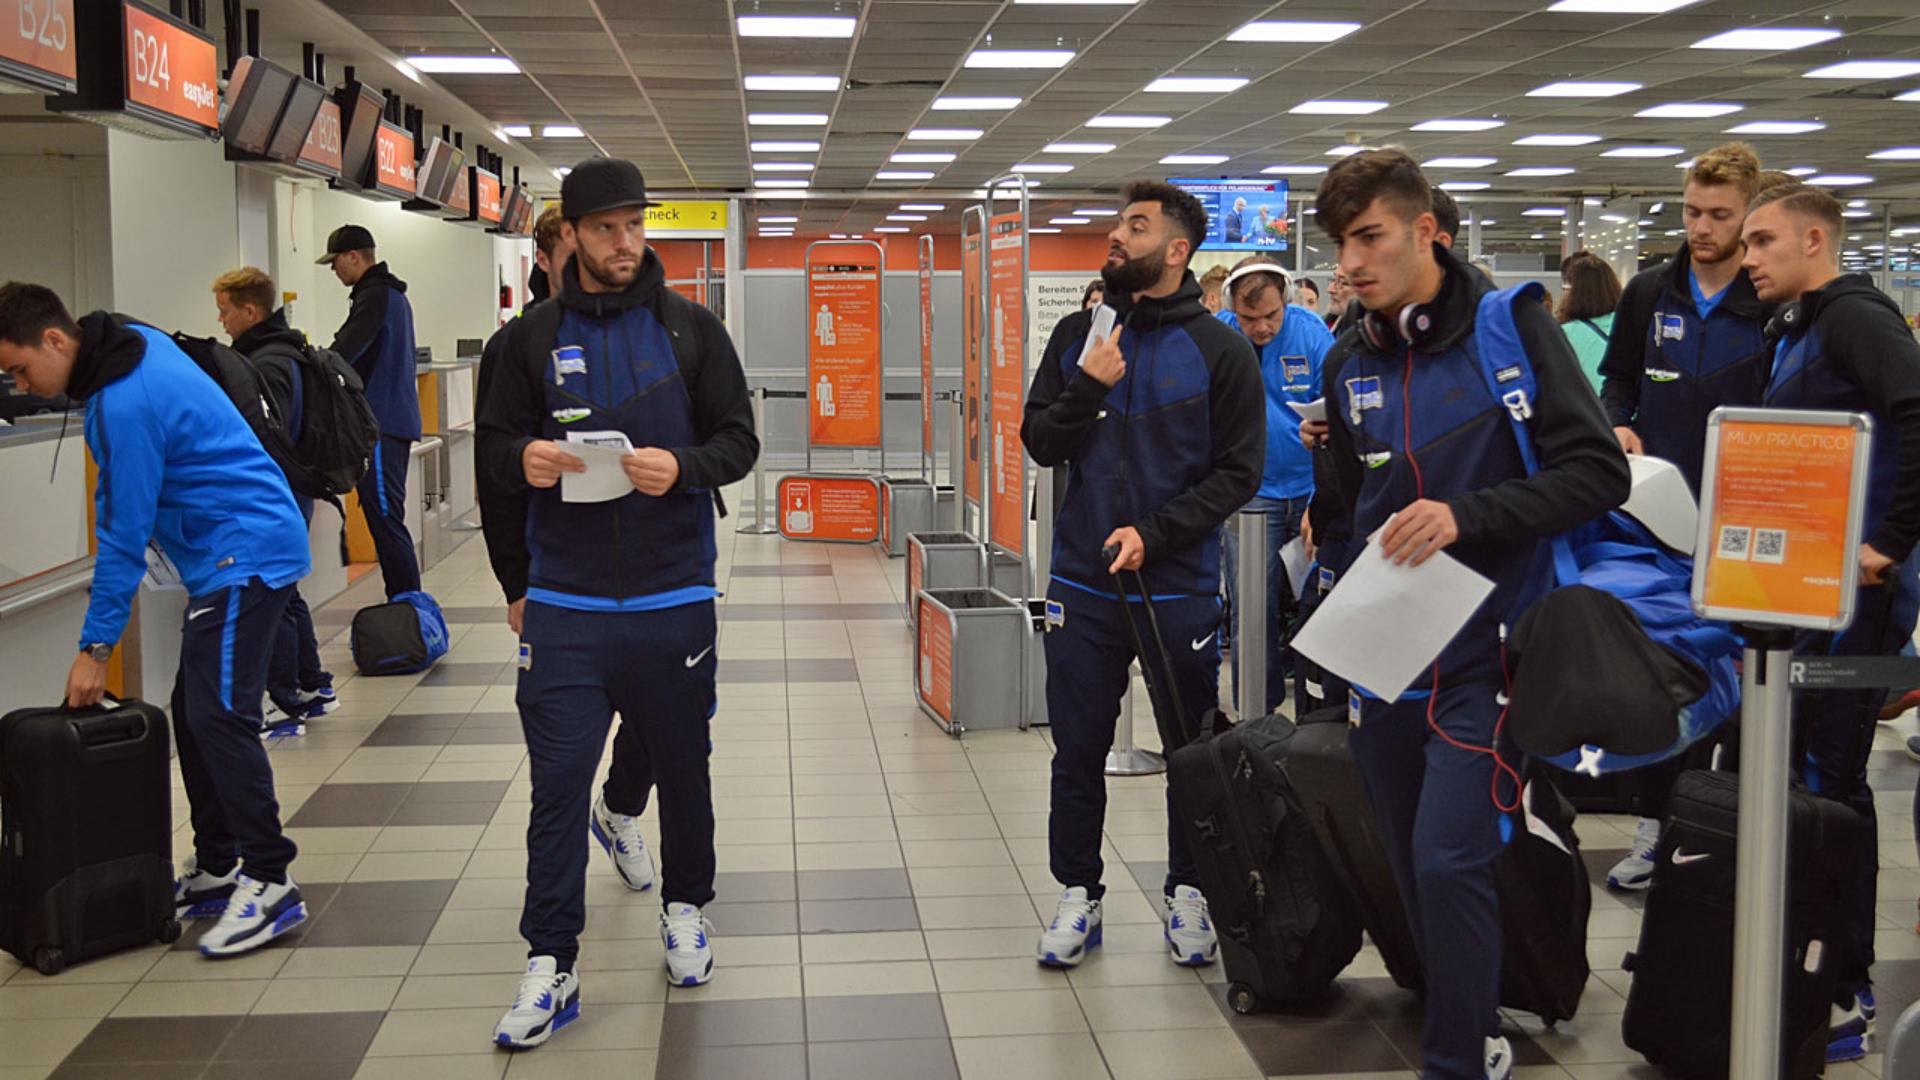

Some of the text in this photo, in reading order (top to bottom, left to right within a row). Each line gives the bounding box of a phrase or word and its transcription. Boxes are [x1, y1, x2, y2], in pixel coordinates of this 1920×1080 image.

[18, 0, 68, 51] B25
[133, 28, 171, 92] B24
[182, 80, 215, 109] easyJet
[710, 211, 718, 220] 2
[1038, 285, 1078, 294] Bereiten
[1038, 297, 1081, 307] Sicherhei
[1038, 310, 1059, 319] Bitte
[1727, 431, 1763, 445] MUY
